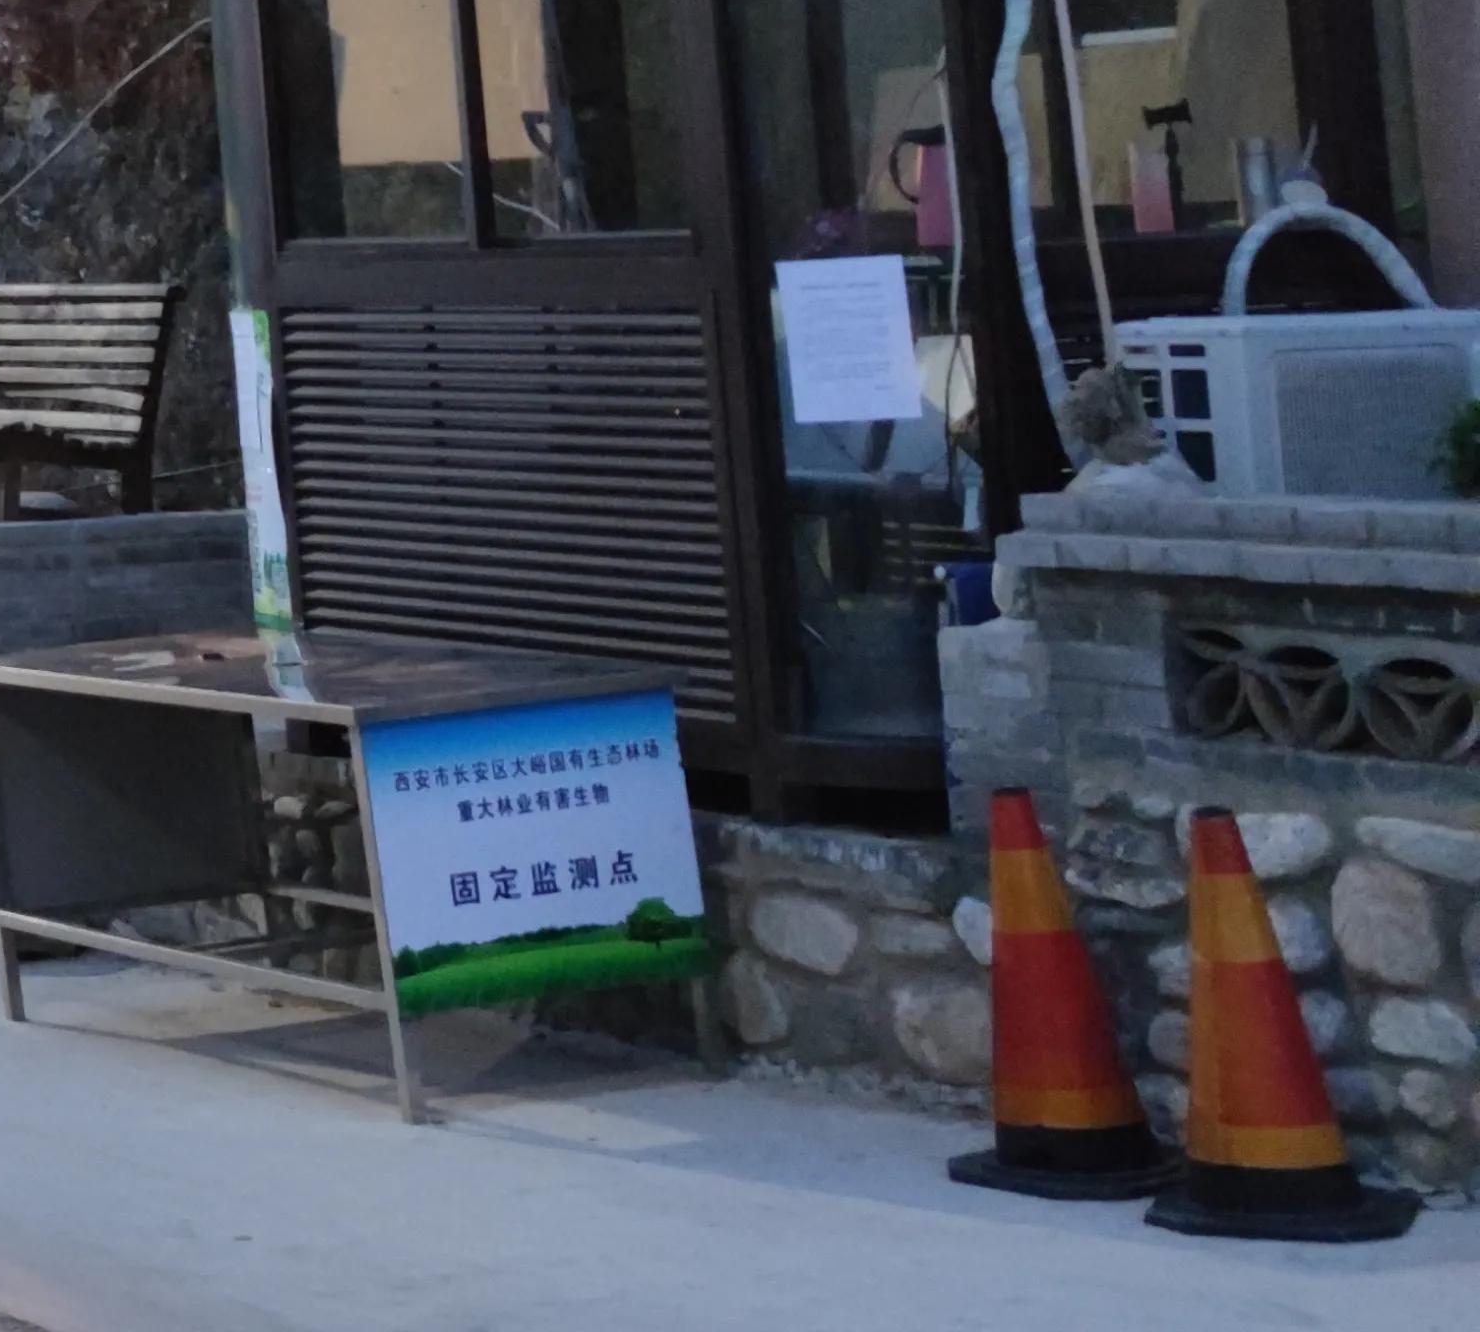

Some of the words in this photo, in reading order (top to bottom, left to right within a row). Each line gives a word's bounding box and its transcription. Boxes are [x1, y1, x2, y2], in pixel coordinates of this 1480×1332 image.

[392, 738, 661, 793] 西安市长安区大峪国有生态林场
[457, 782, 611, 823] 重大林业有害生物
[449, 849, 639, 908] 固定监测点
